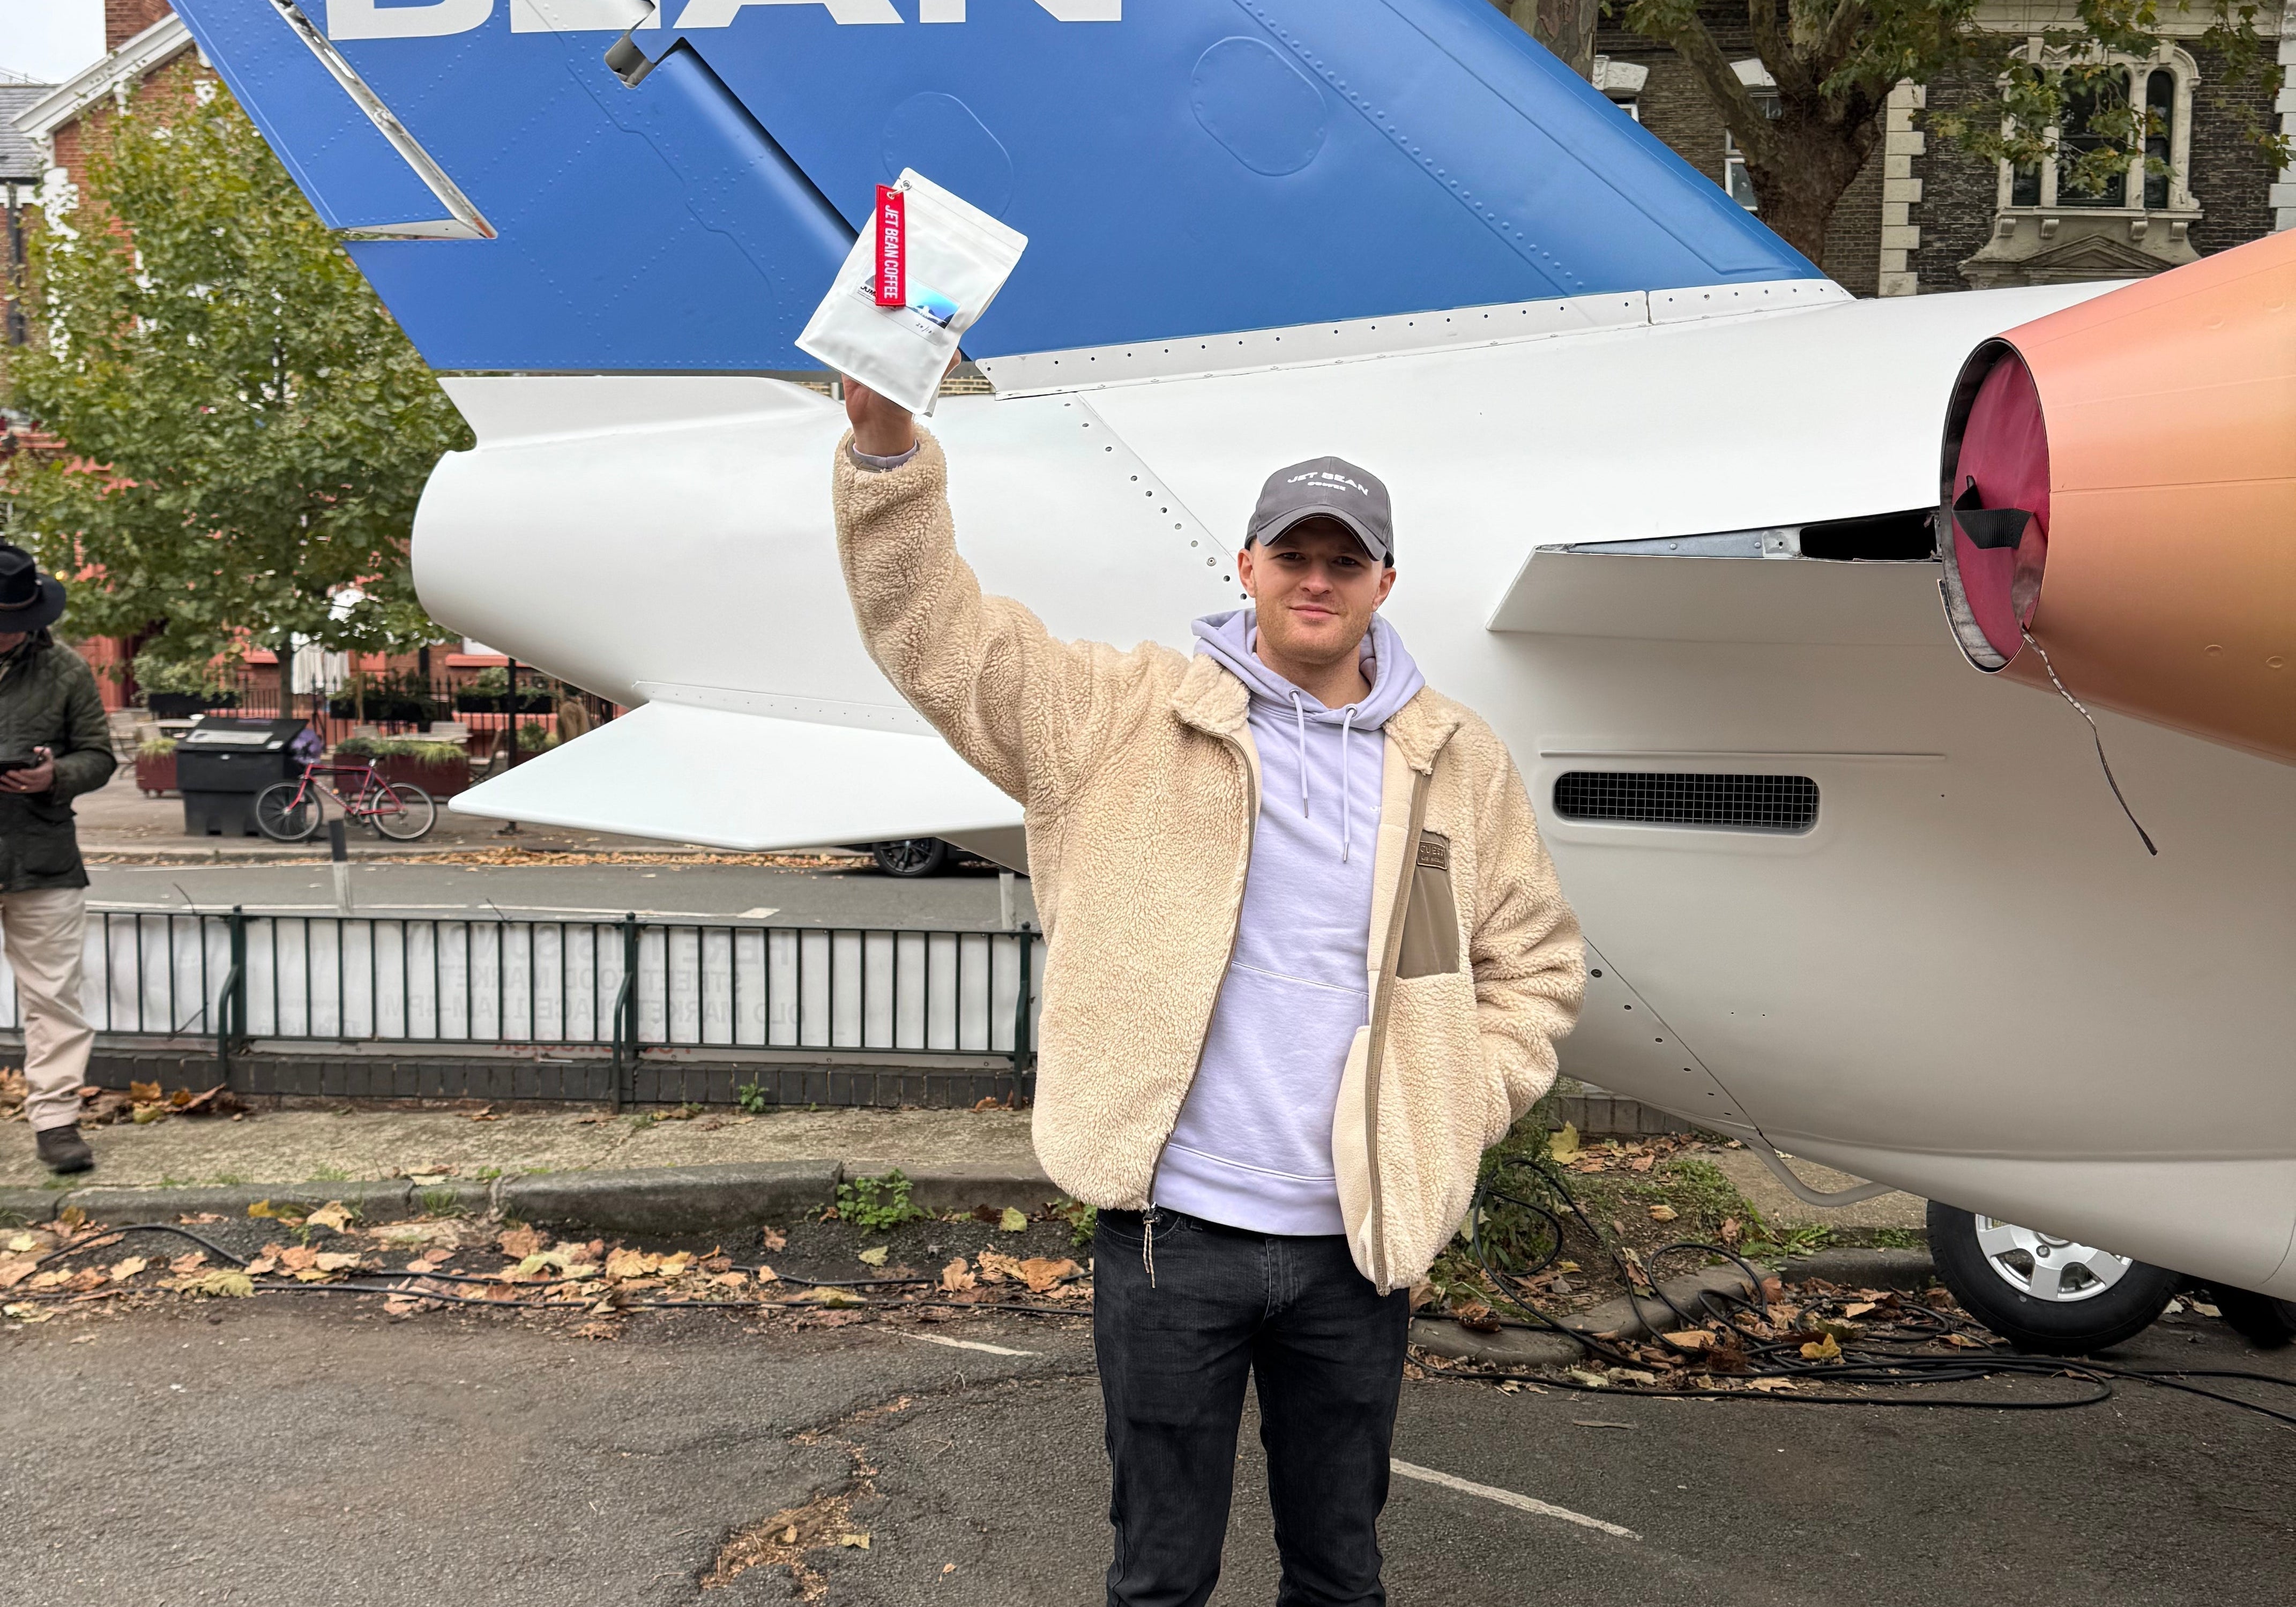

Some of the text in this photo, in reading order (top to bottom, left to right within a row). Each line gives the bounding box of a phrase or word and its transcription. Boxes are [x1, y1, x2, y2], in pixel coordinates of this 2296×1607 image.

[884, 204, 899, 299] JET BEAN COFFEE
[860, 286, 876, 297] JUM
[1287, 472, 1368, 496] JET BEAN
